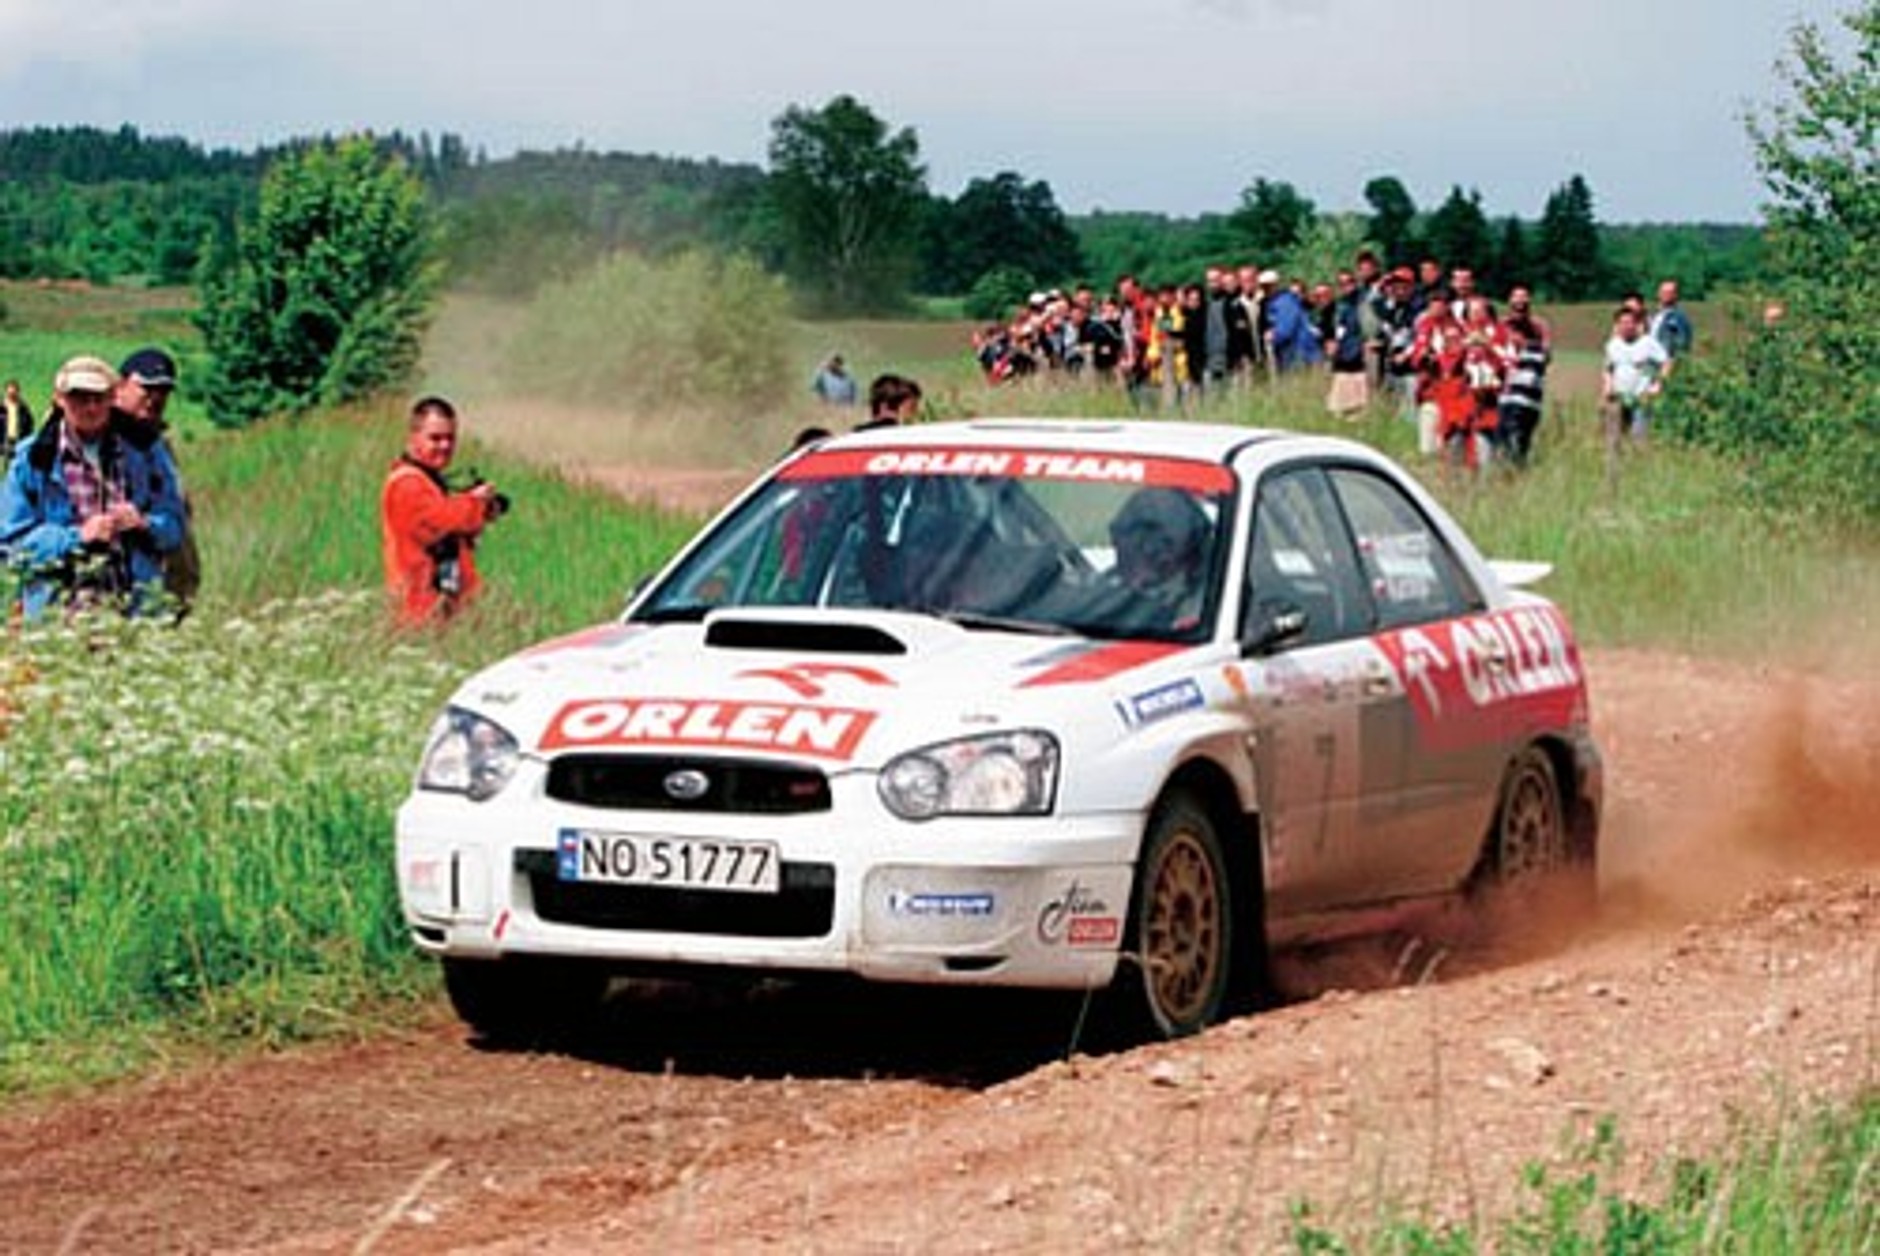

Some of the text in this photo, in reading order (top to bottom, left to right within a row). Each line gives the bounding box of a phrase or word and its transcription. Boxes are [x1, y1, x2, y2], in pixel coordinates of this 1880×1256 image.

[866, 452, 1145, 480] ORLEN TEAM
[1452, 605, 1577, 706] ORLEN
[561, 702, 854, 750] ORLEN
[583, 839, 770, 885] NO 51777
